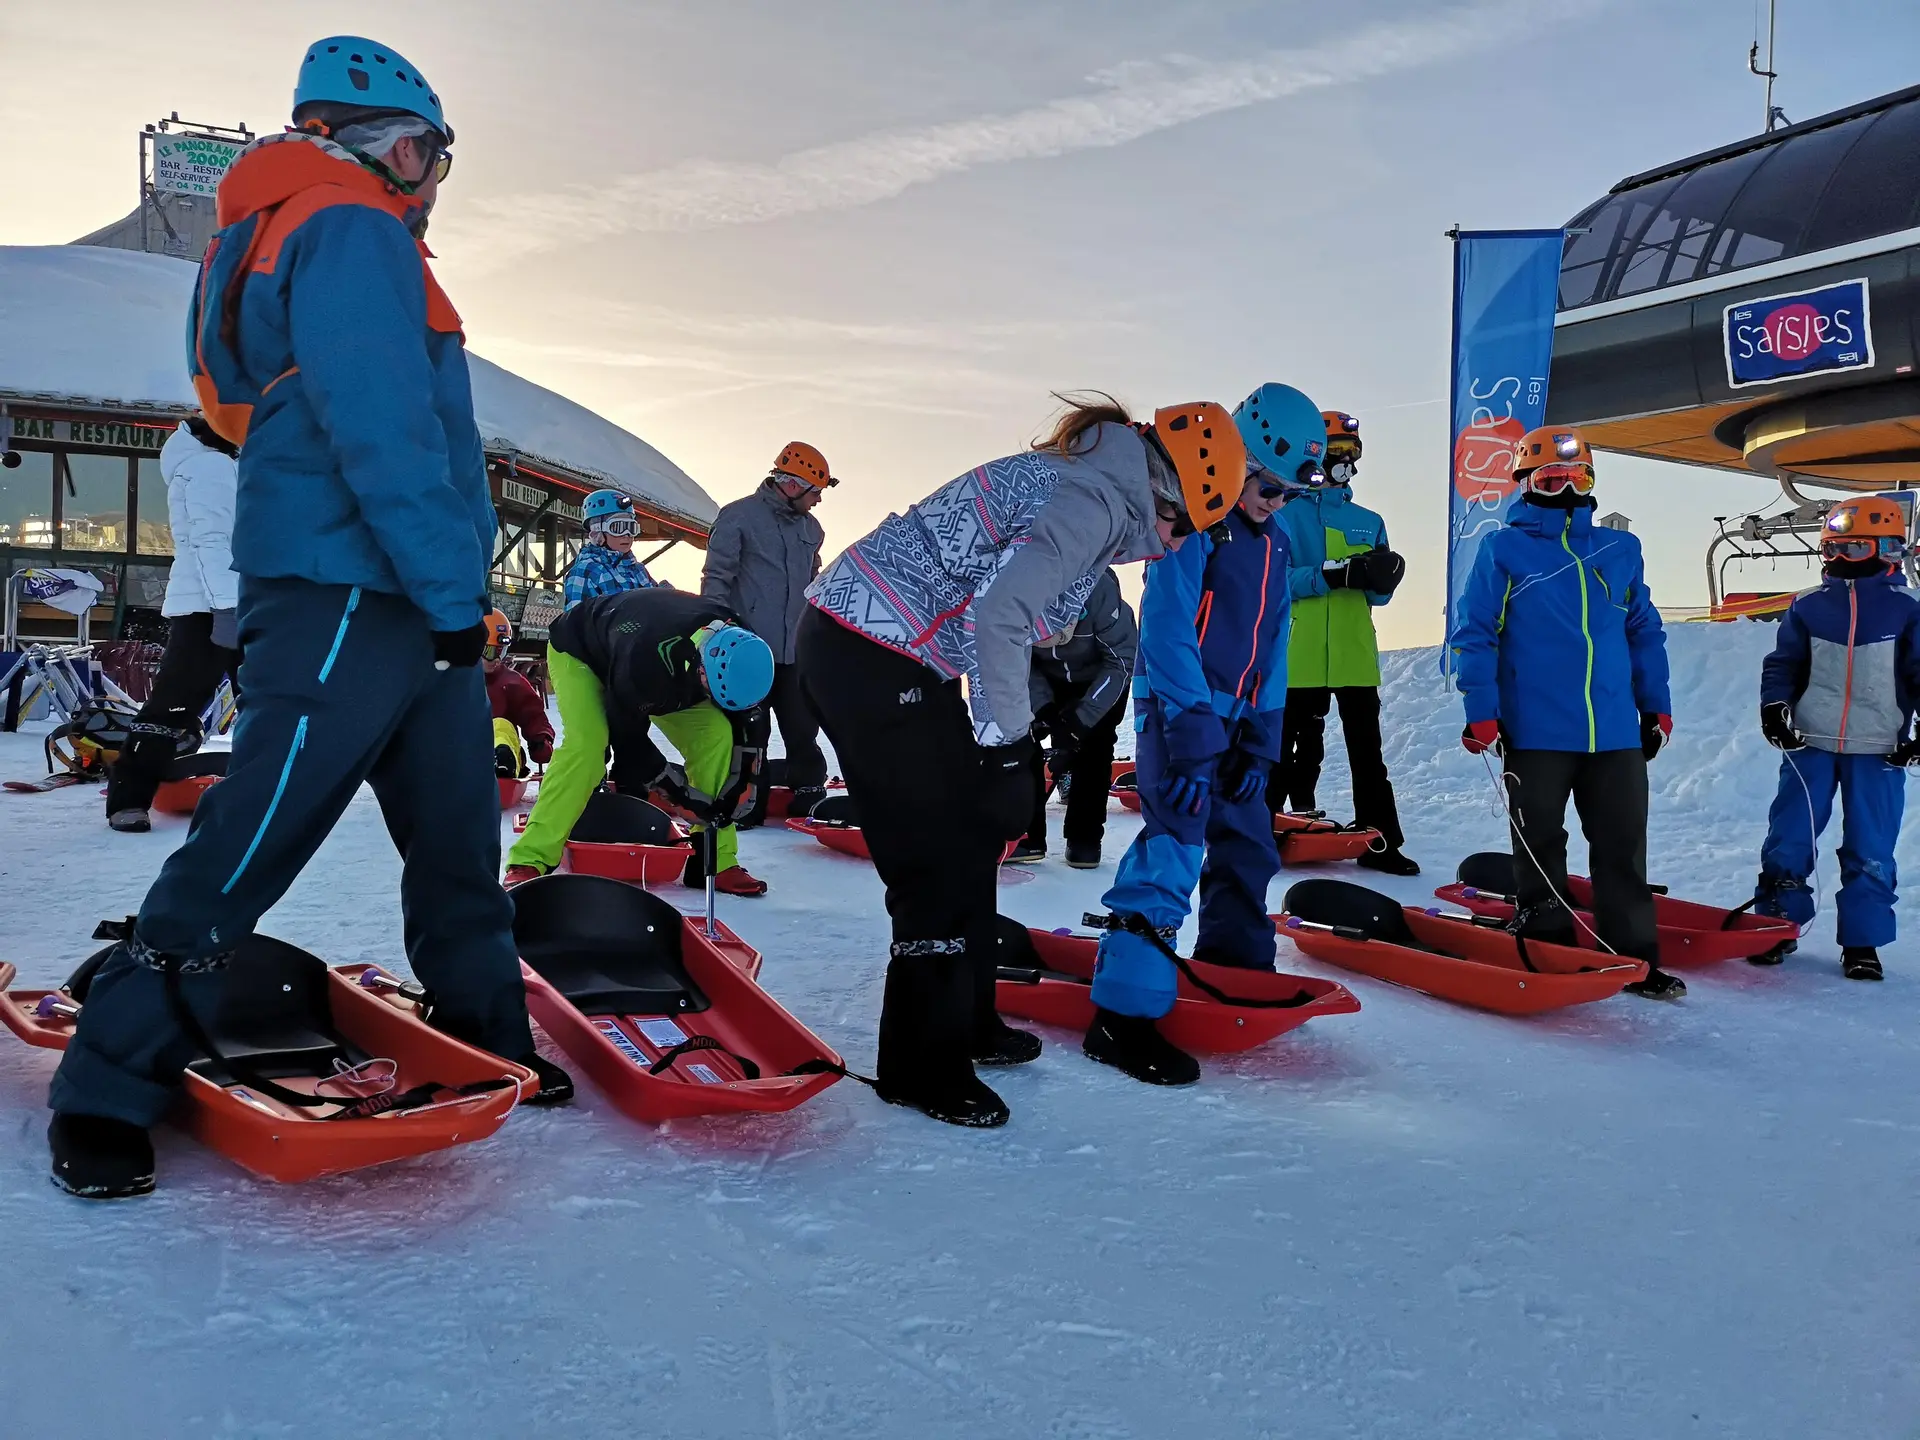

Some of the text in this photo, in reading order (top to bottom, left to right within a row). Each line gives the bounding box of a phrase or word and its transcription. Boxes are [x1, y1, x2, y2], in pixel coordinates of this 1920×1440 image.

[158, 145, 173, 158] LE
[160, 160, 180, 170] BAR
[187, 151, 230, 168] 2000
[160, 170, 210, 184] SELF-SERVICE
[176, 181, 189, 189] 04
[1734, 310, 1752, 321] les
[1527, 377, 1546, 406] les
[14, 416, 168, 448] BAR RESTAURA
[506, 481, 519, 500] BAR
